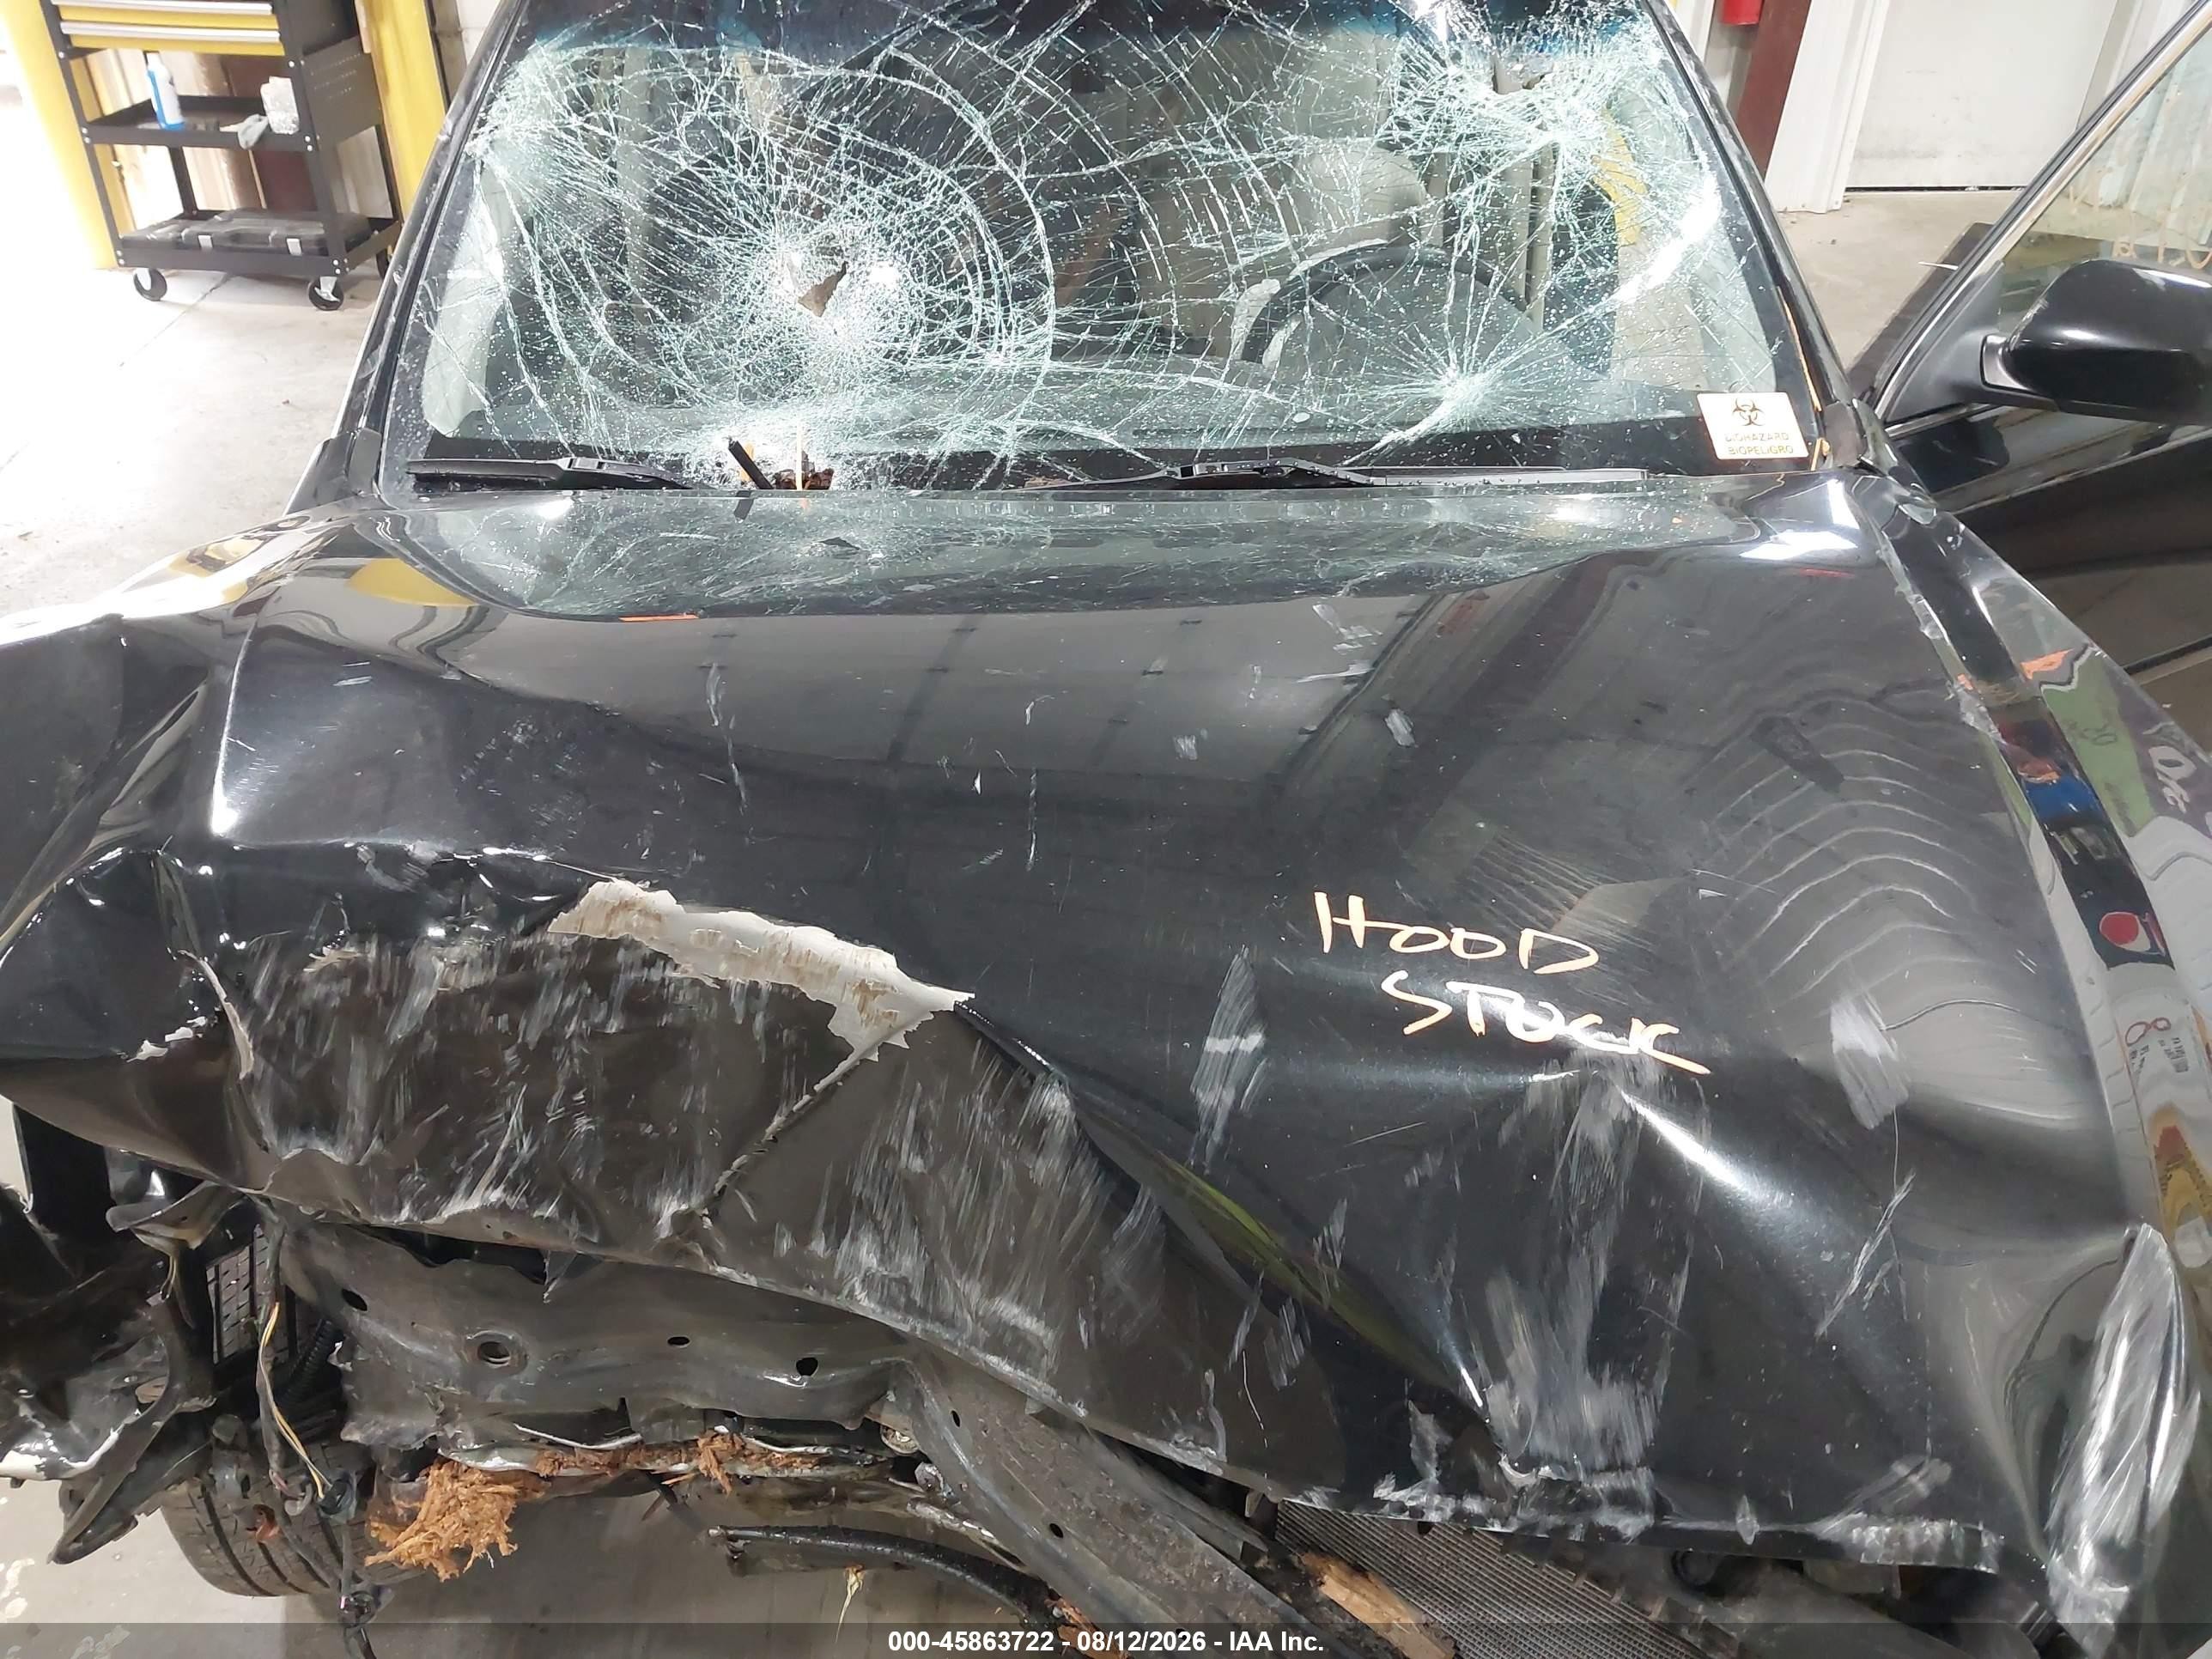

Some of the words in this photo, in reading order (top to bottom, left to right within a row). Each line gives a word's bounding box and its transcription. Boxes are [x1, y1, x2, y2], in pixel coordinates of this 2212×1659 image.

[1724, 432, 1790, 442] BIOHAZARD
[1728, 445, 1794, 455] BIOPELIGRO
[1314, 891, 1599, 974] HOOD
